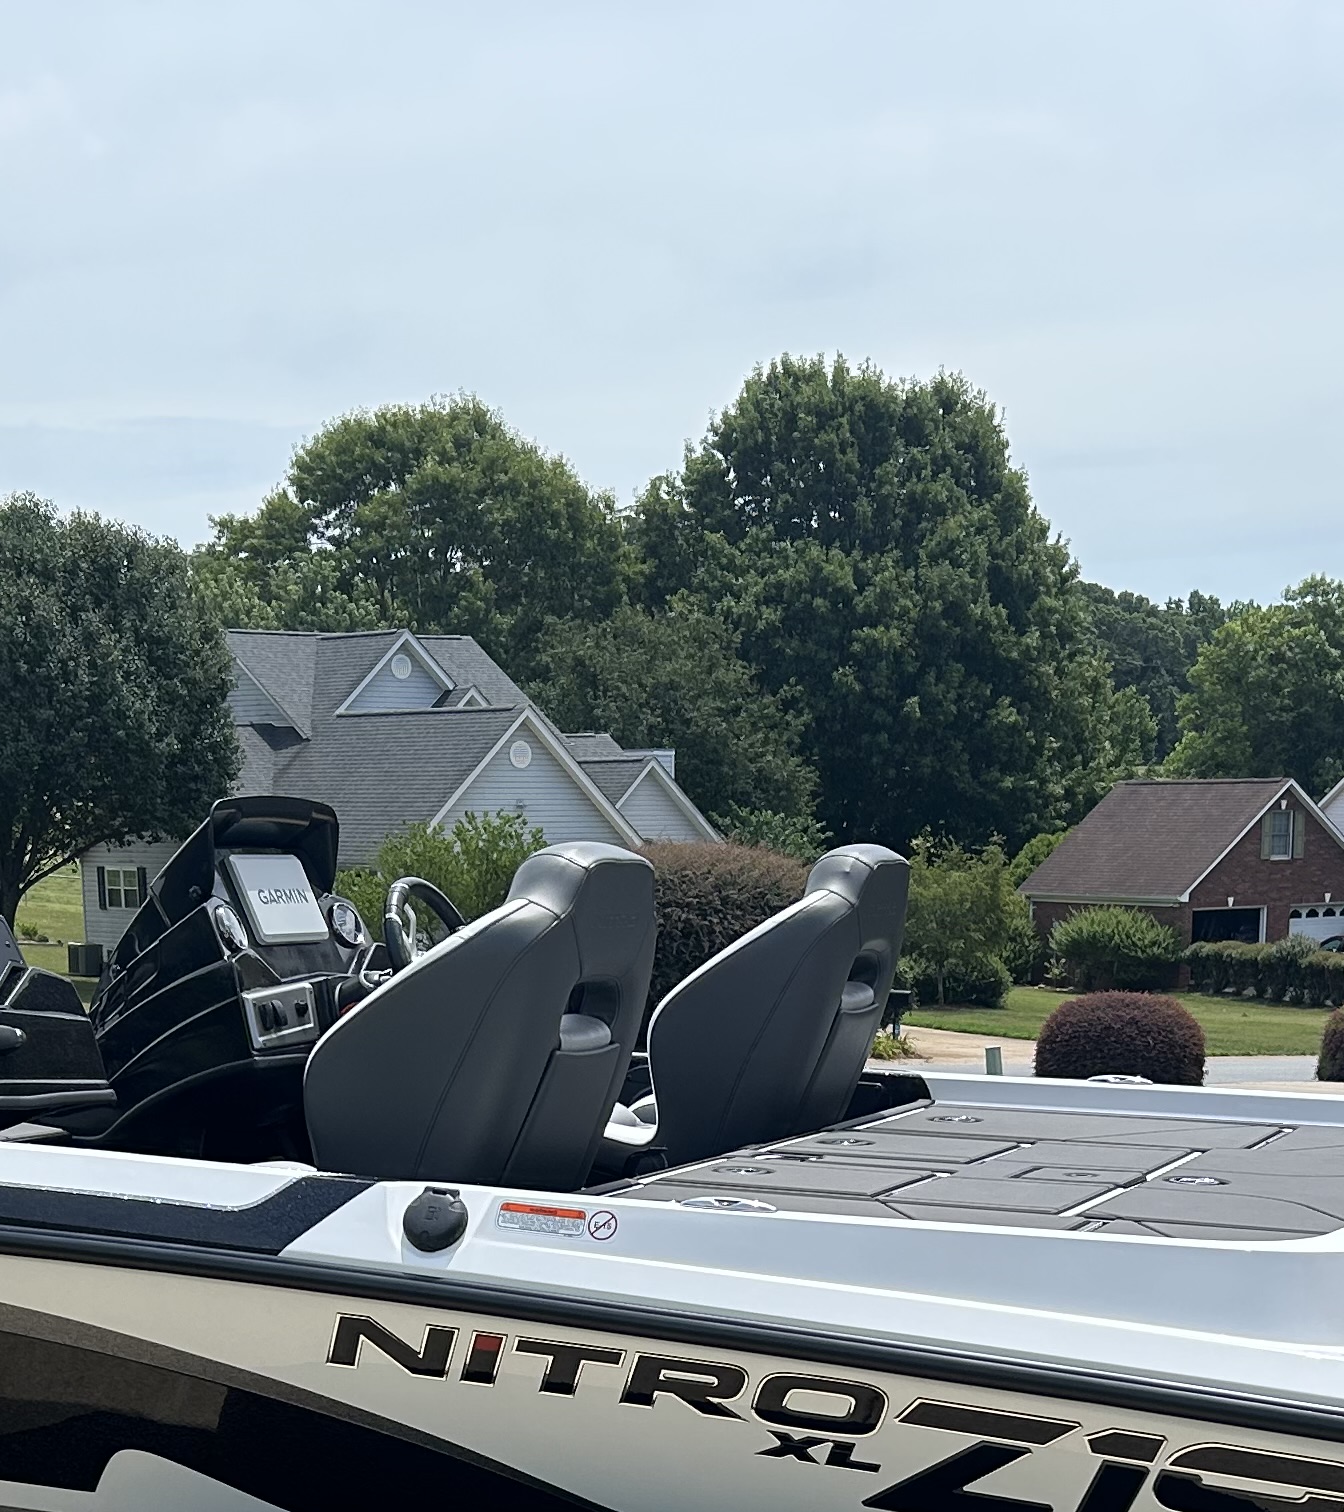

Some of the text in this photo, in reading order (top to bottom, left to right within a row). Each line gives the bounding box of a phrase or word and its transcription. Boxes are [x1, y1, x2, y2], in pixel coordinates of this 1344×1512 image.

[257, 887, 309, 905] GARMIN
[326, 1312, 889, 1438] NITRO
[754, 1430, 882, 1474] XL
